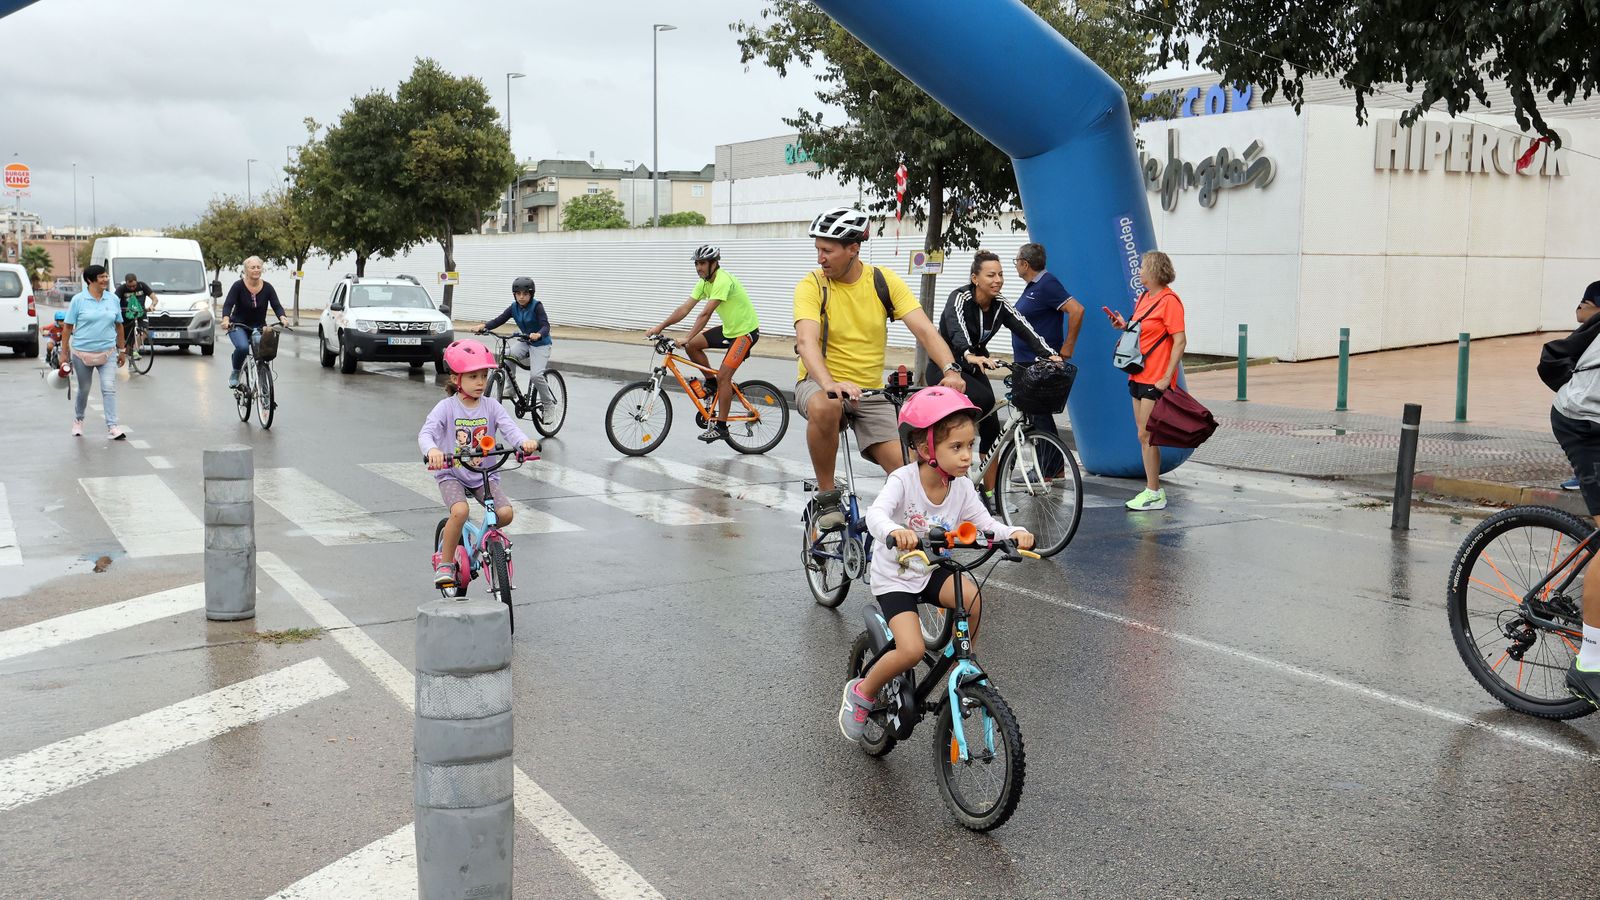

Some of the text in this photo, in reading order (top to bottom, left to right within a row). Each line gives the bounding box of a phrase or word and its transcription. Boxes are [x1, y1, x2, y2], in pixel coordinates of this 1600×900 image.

[1375, 118, 1572, 176] HIPERCOR
[5, 176, 30, 184] KING
[1120, 217, 1146, 303] deportes@a
